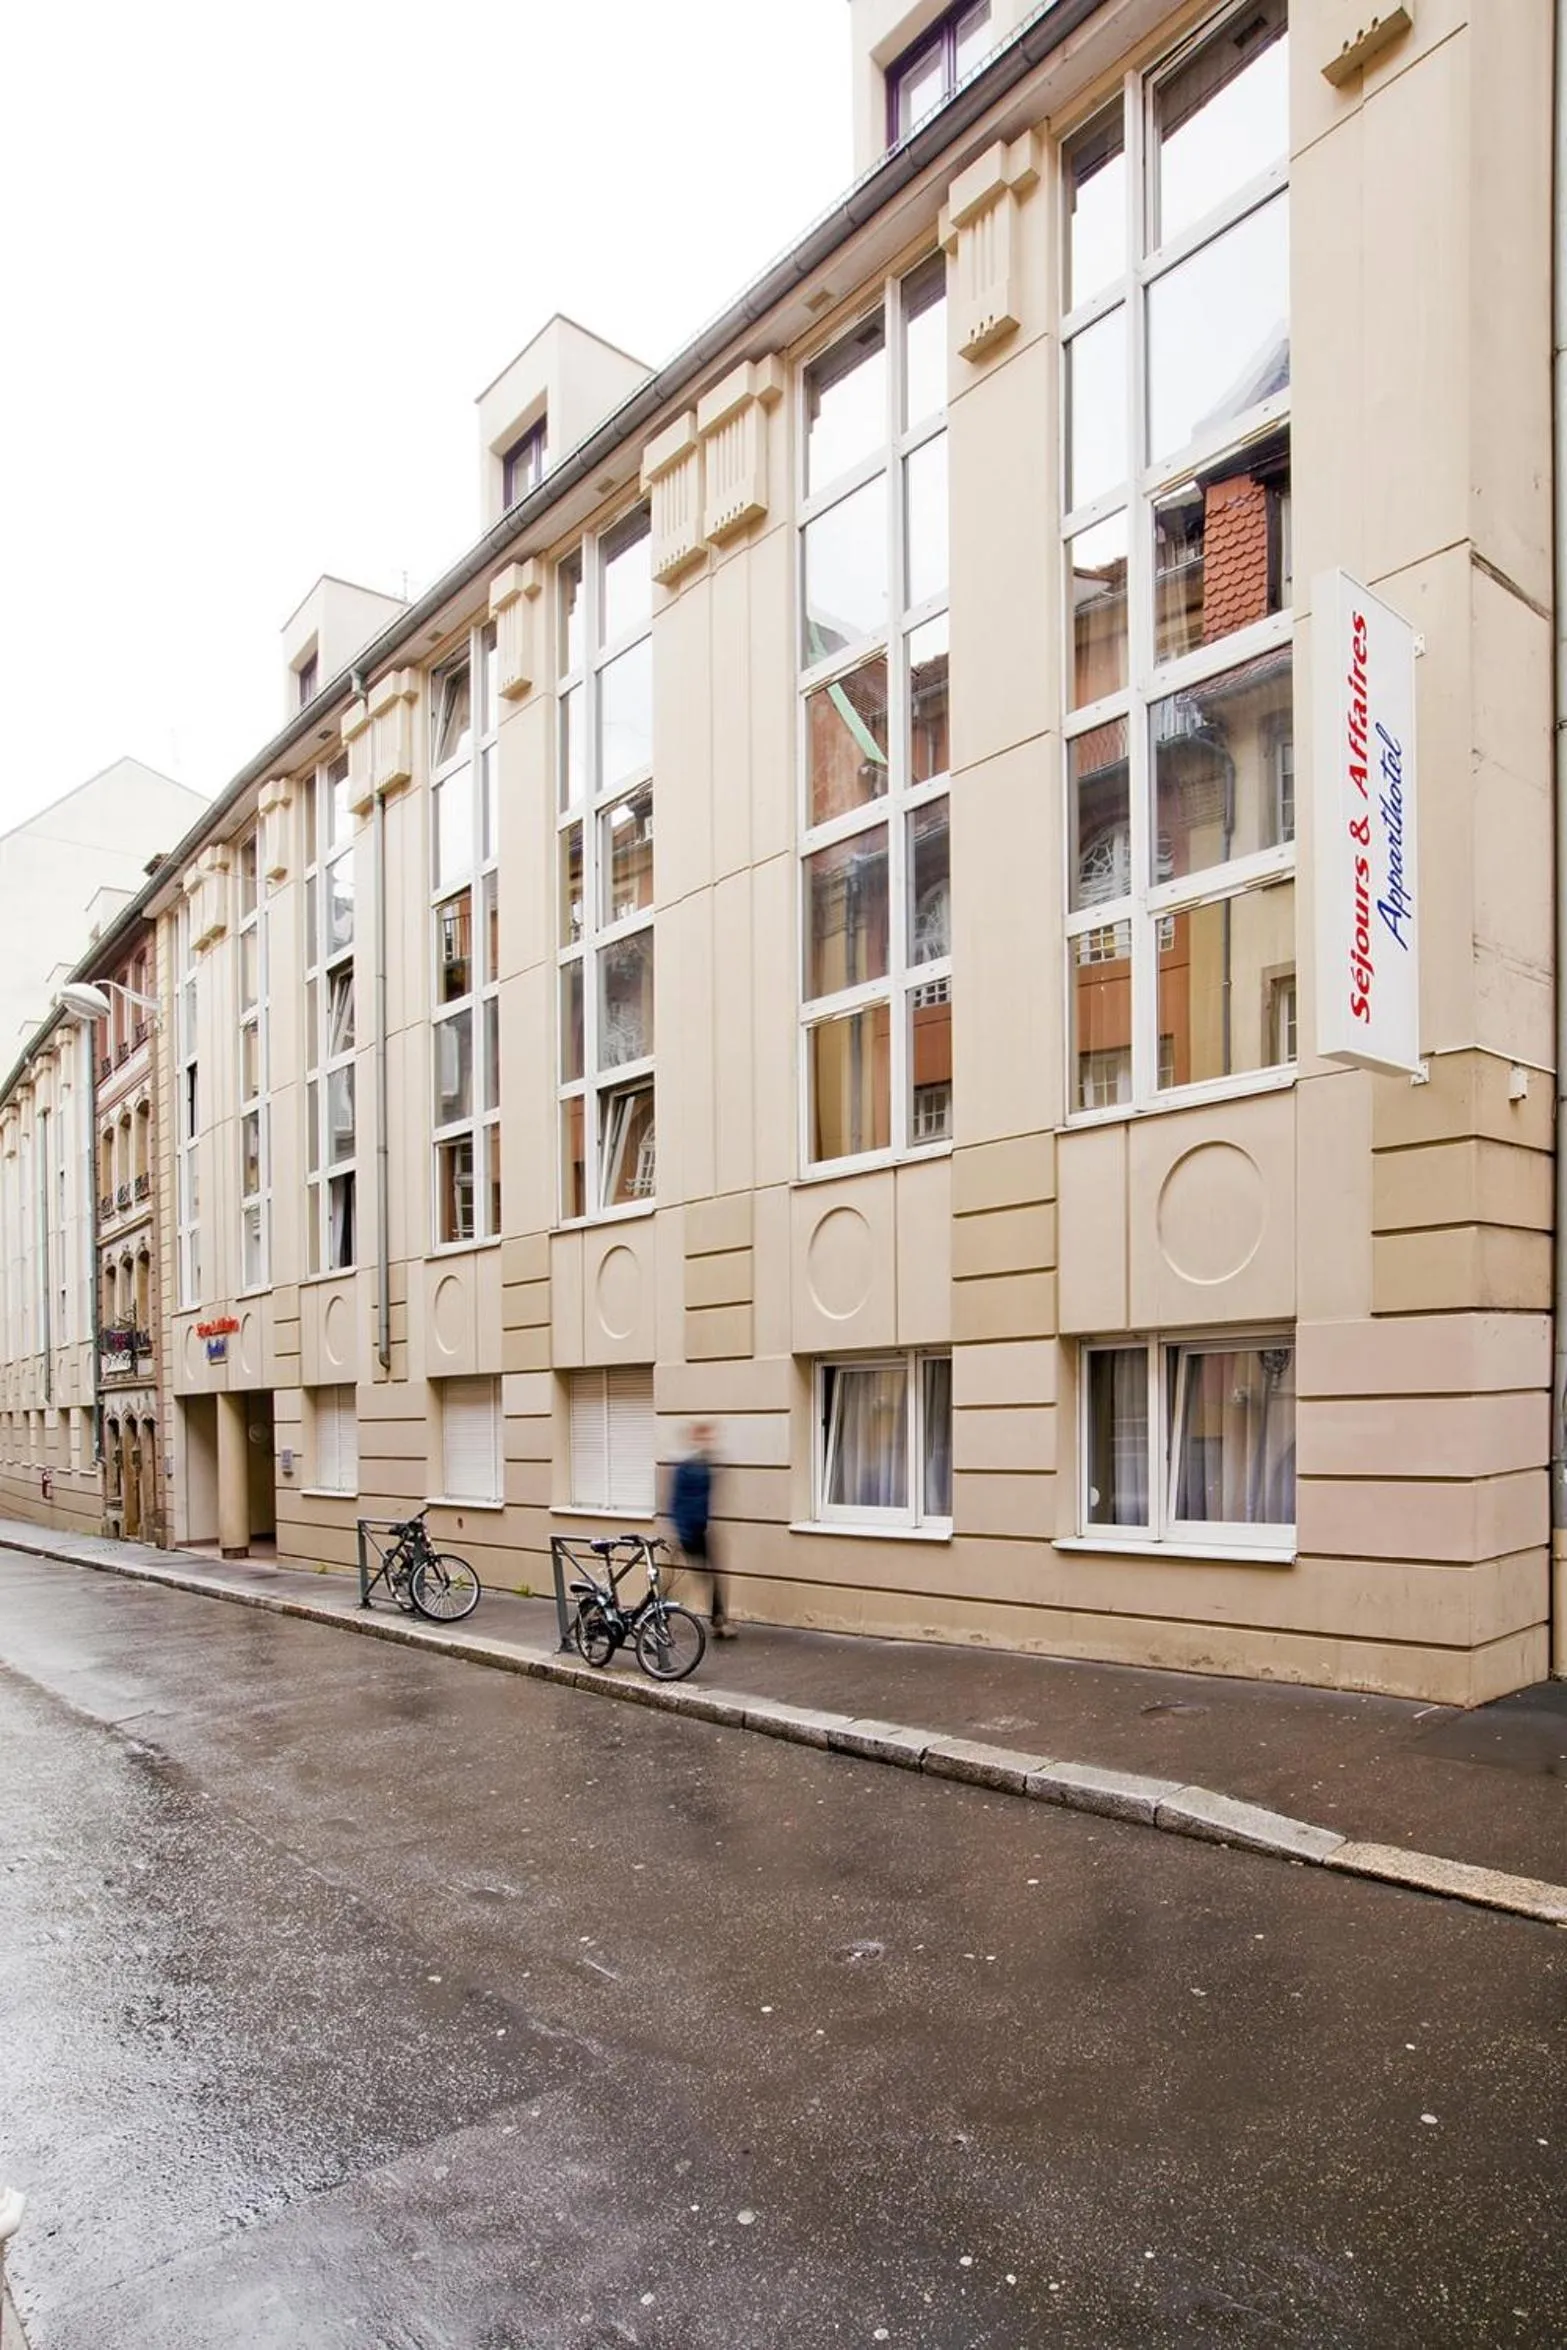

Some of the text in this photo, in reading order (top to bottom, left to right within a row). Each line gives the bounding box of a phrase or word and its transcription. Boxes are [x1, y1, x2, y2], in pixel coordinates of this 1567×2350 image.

[1348, 611, 1375, 1024] Séjours & Affaires
